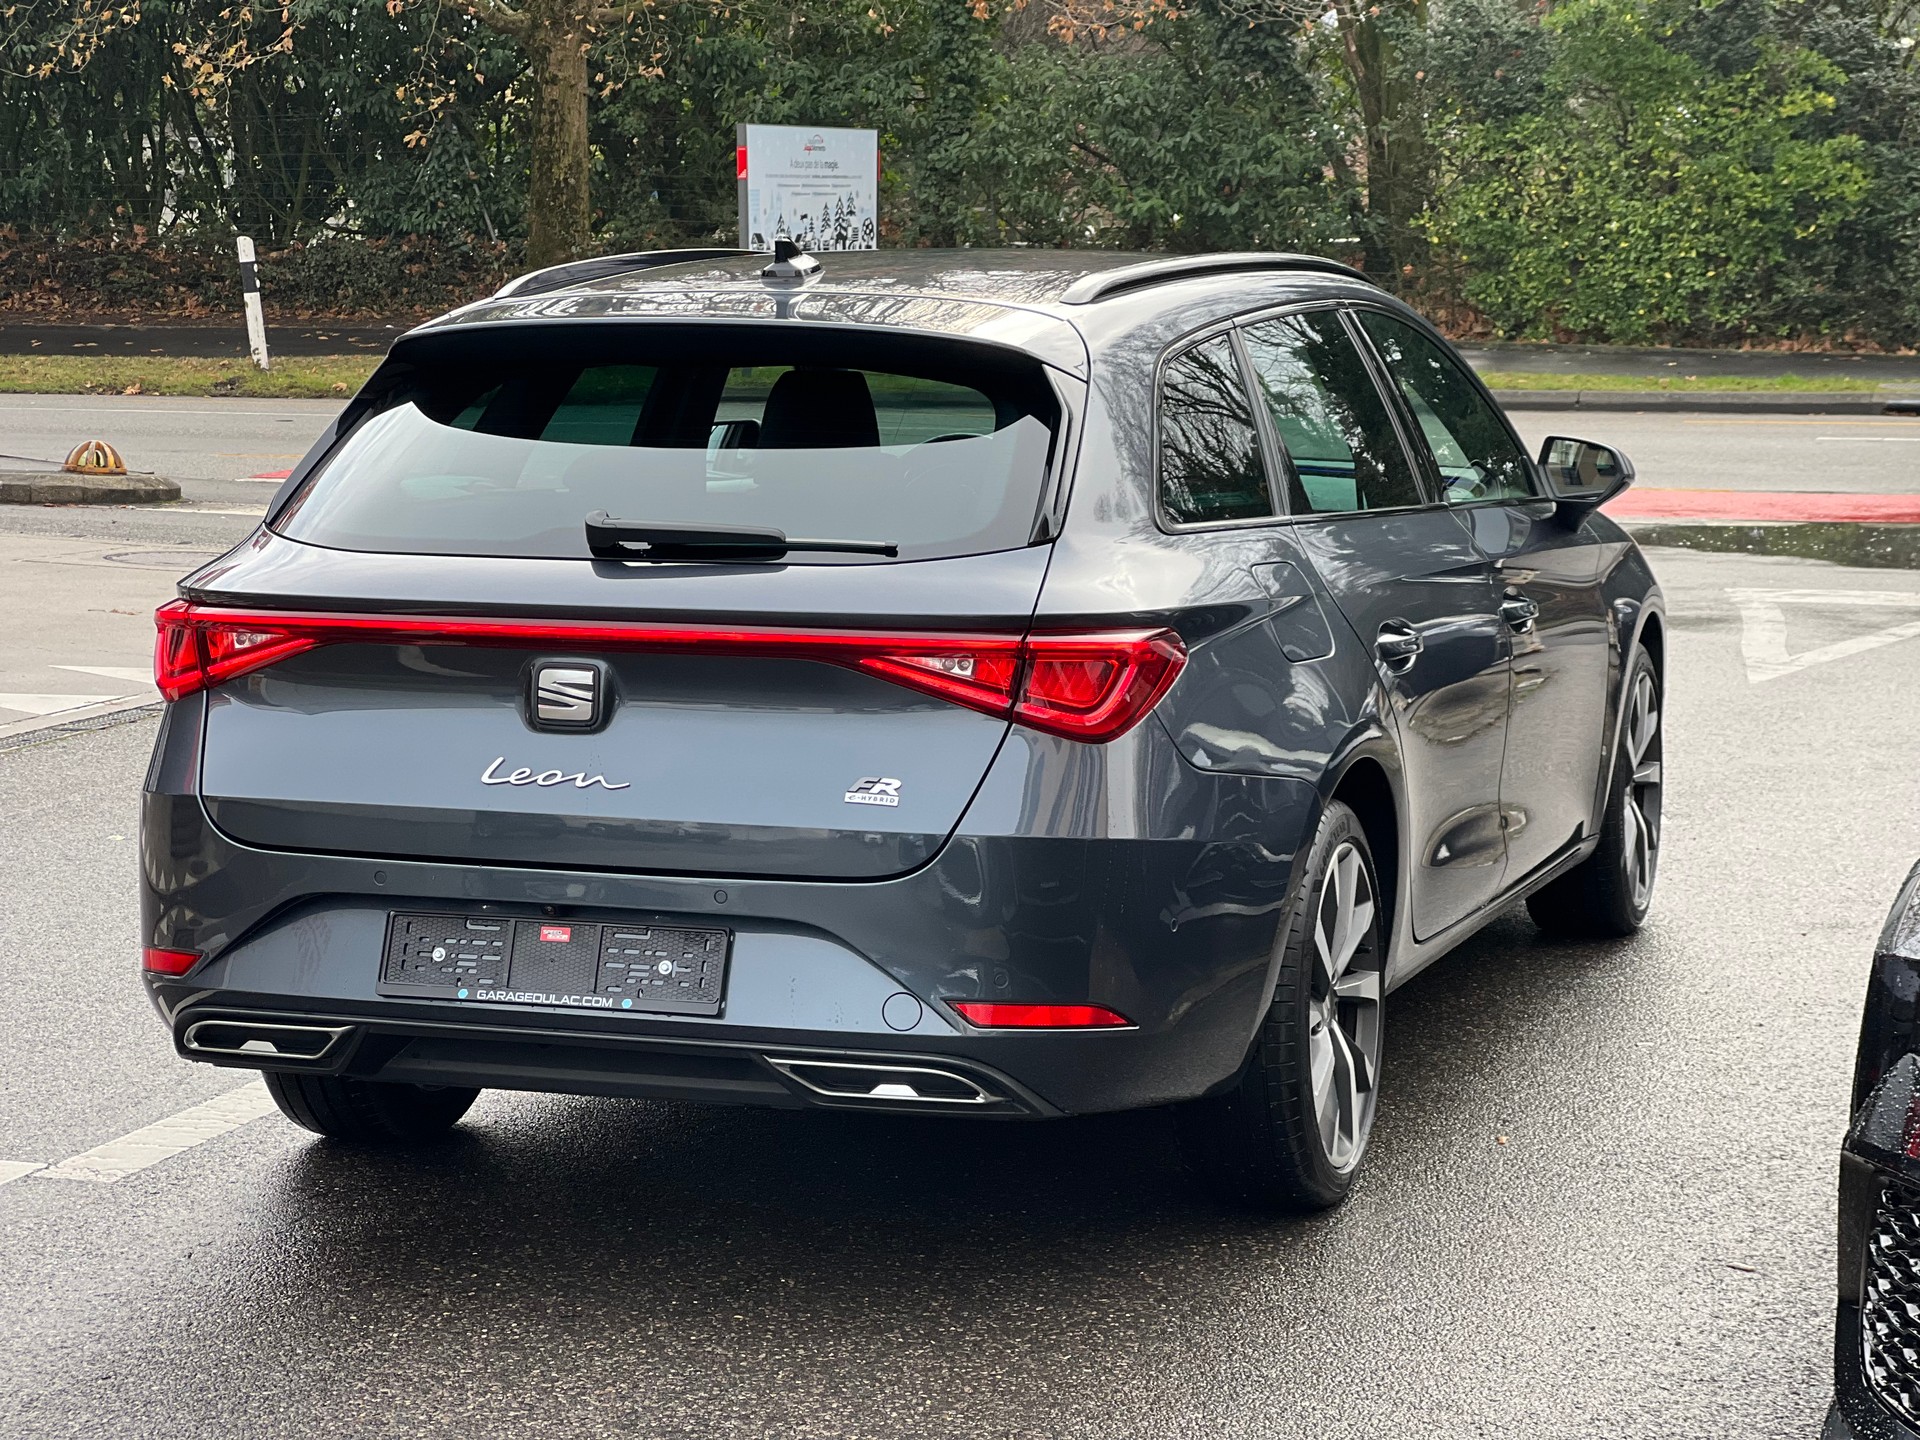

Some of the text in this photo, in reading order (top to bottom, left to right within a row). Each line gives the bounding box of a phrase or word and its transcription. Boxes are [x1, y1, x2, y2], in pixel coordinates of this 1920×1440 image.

[480, 756, 630, 790] Leon
[847, 776, 902, 796] FR
[476, 989, 613, 1008] GARAGEDULAC.COM
